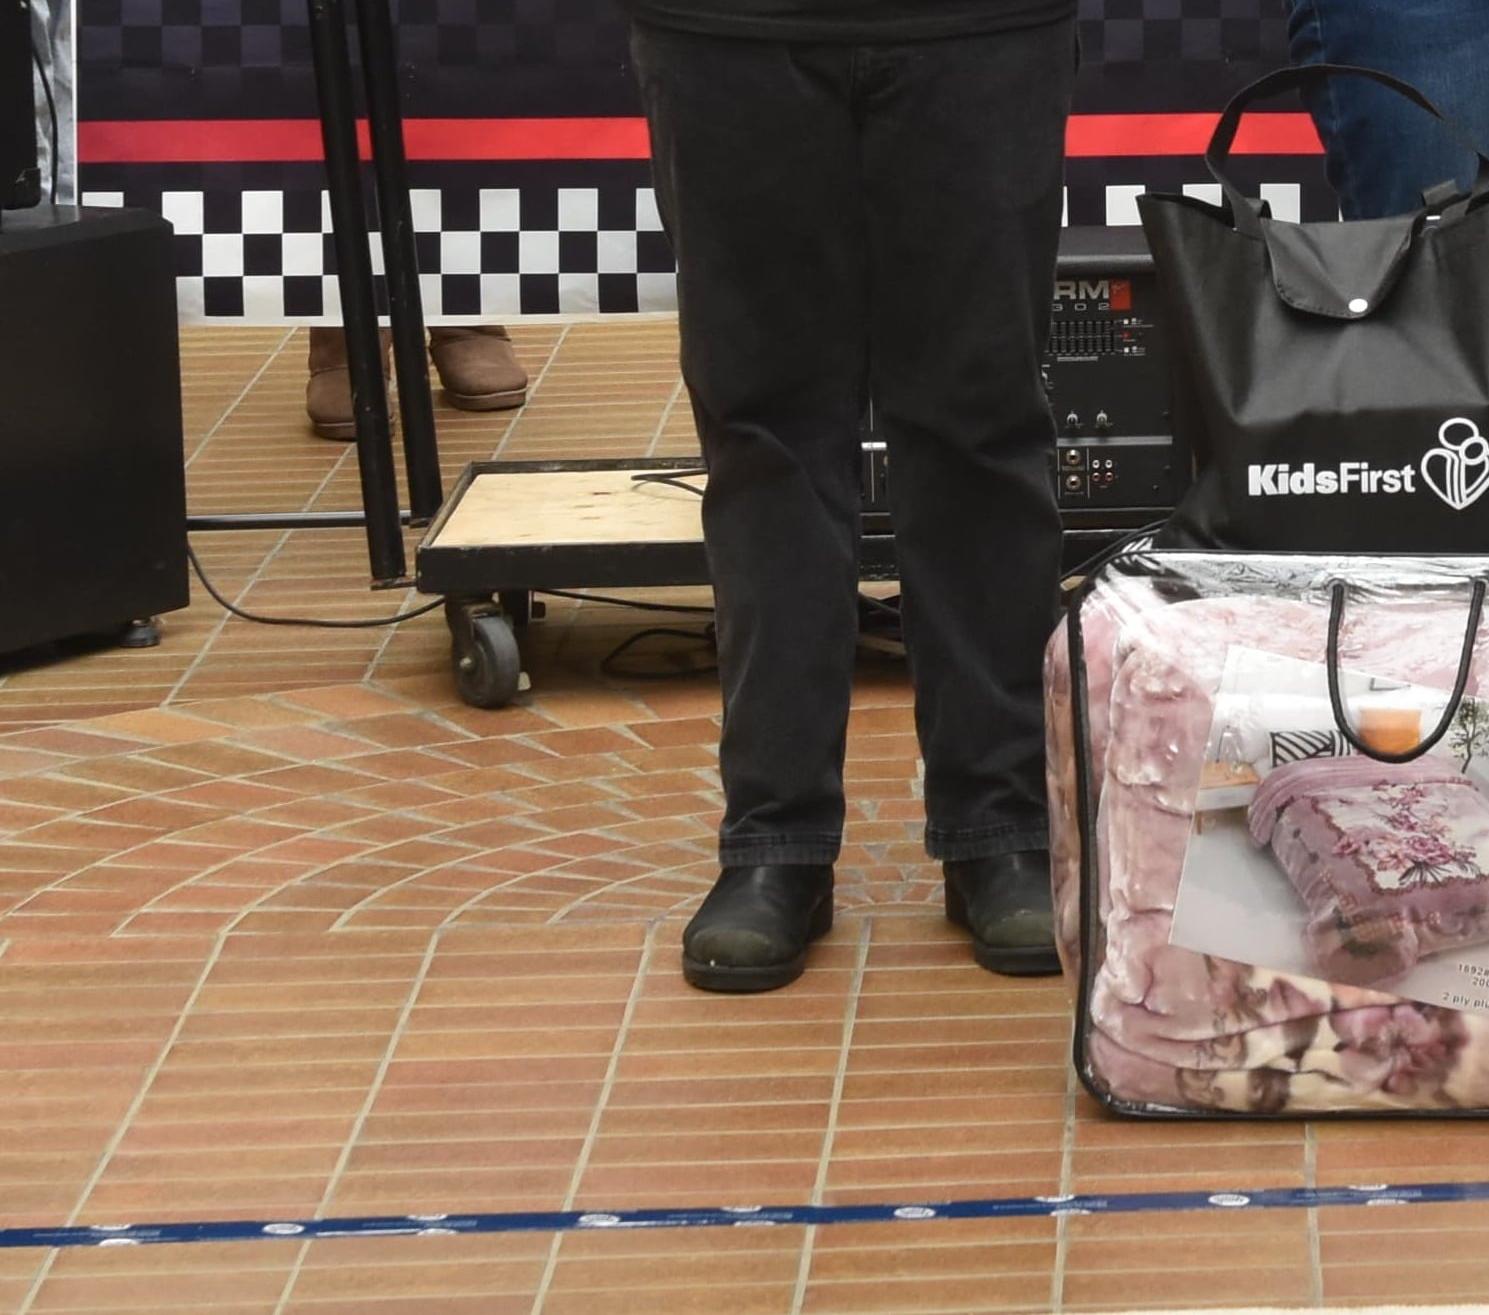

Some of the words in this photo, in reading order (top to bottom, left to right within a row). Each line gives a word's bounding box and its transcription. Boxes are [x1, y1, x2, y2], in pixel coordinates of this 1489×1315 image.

[1248, 462, 1416, 496] KidsFirst
[1442, 991, 1450, 1001] 2
[1452, 994, 1471, 1005] ply
